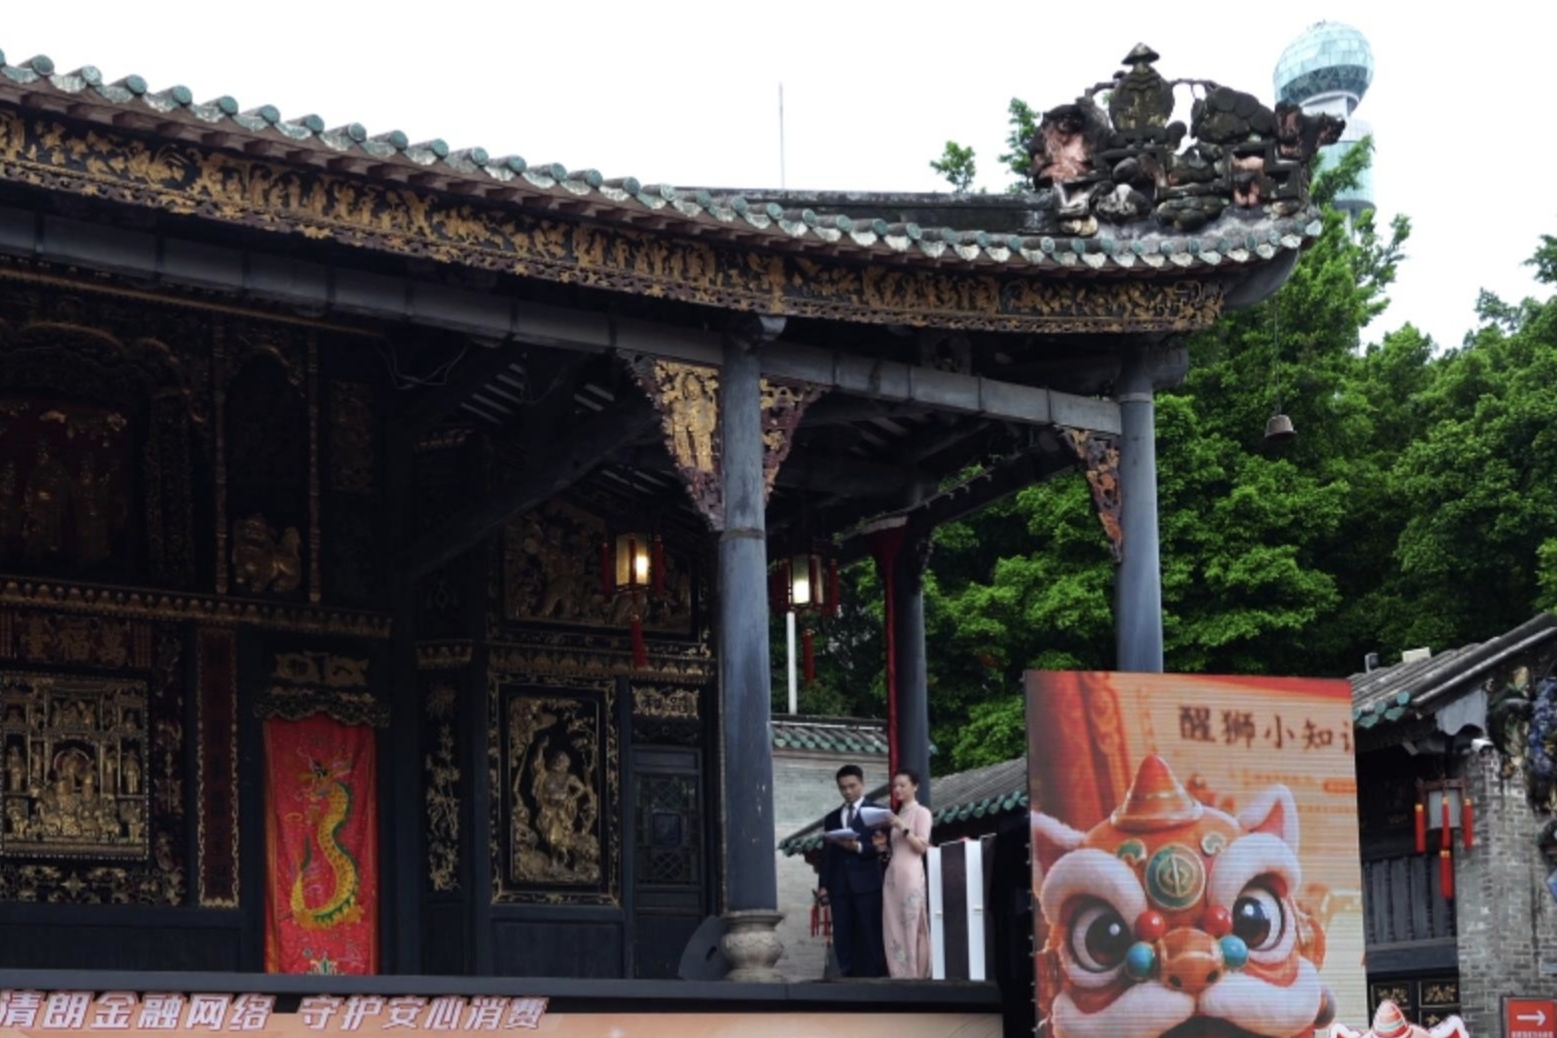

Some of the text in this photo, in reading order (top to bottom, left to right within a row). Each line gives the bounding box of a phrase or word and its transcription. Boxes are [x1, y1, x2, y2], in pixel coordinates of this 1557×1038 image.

[300, 994, 548, 1030] 守护安心消费
